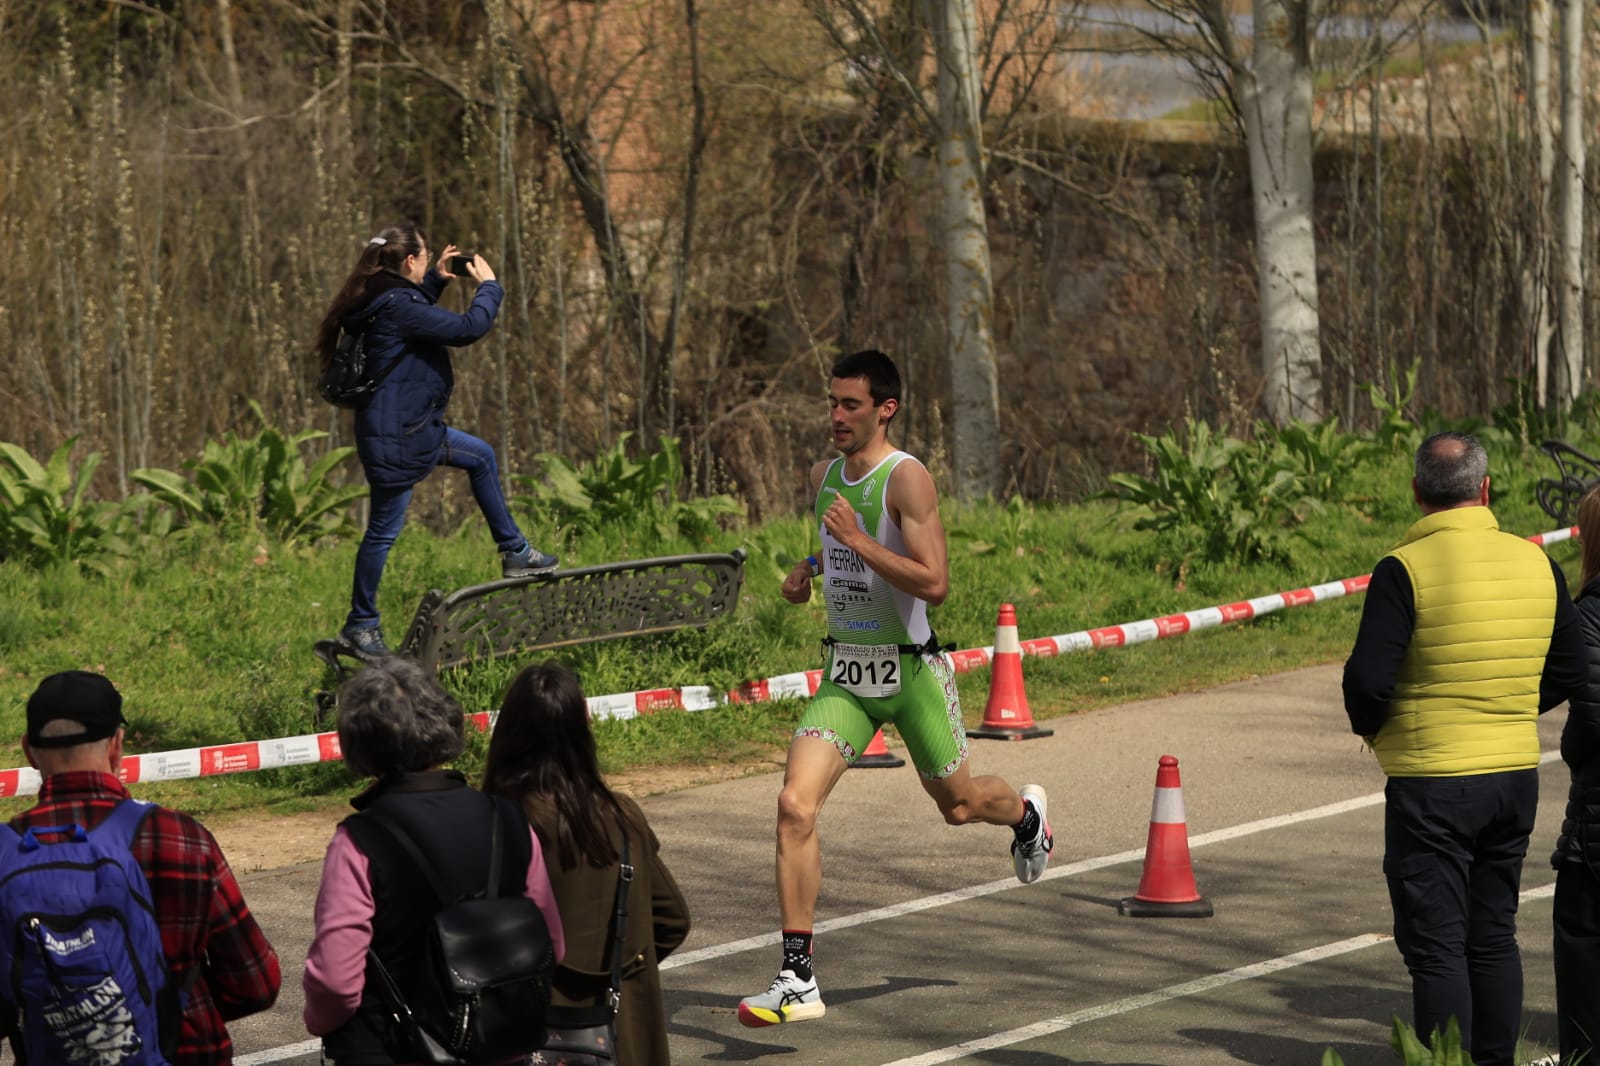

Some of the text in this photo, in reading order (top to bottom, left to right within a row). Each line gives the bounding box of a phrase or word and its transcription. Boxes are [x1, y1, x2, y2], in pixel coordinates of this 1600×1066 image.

[829, 548, 865, 573] HERRAN
[847, 619, 880, 630] SIMAG
[833, 659, 897, 686] 2012
